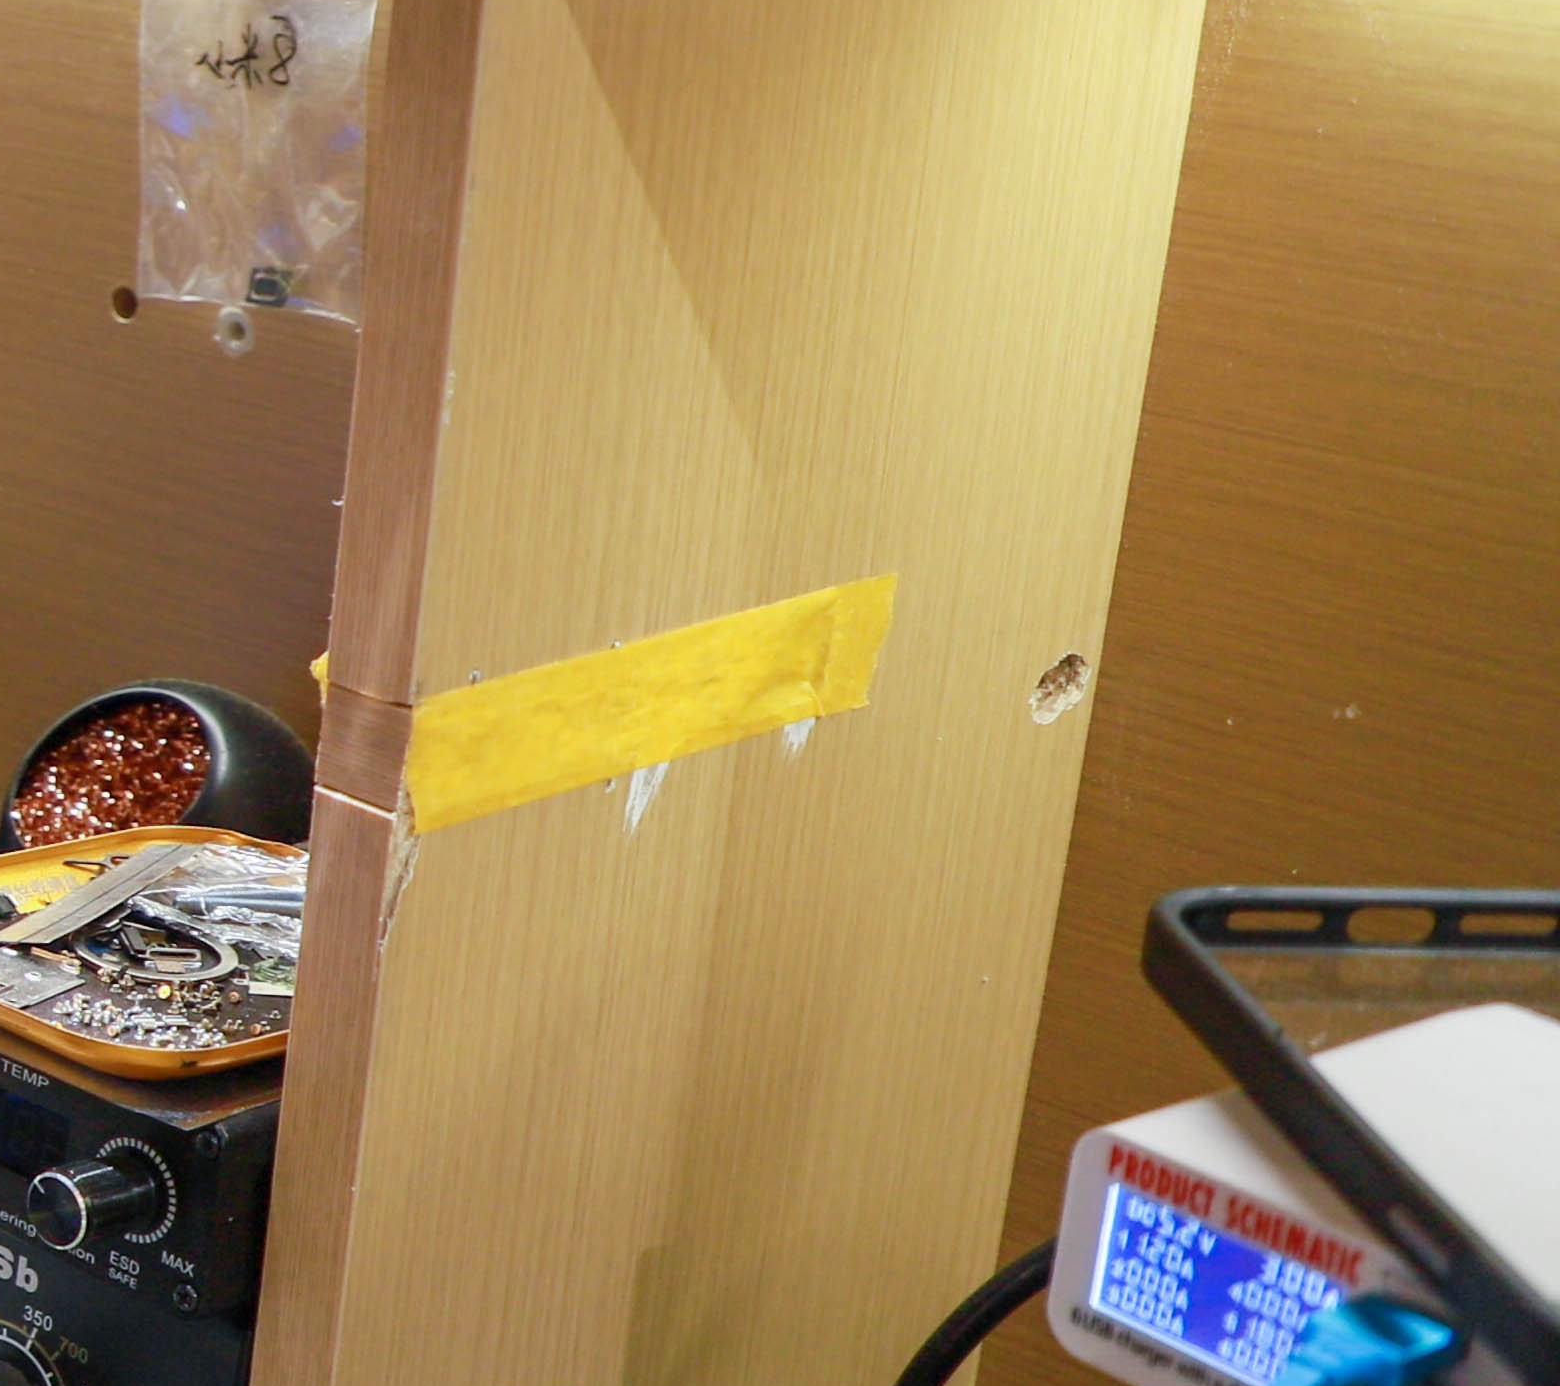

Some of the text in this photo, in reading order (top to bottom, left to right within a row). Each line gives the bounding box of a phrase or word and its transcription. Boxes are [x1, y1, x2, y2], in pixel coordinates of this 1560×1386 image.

[0, 1058, 49, 1088] TEMP
[1108, 1144, 1364, 1288] PRODUCT SCHEMATIC
[109, 1250, 140, 1276] ESD
[161, 1251, 195, 1278] MAX
[108, 1268, 138, 1290] SAFE
[23, 1305, 53, 1332] 350
[58, 1336, 89, 1364] 700
